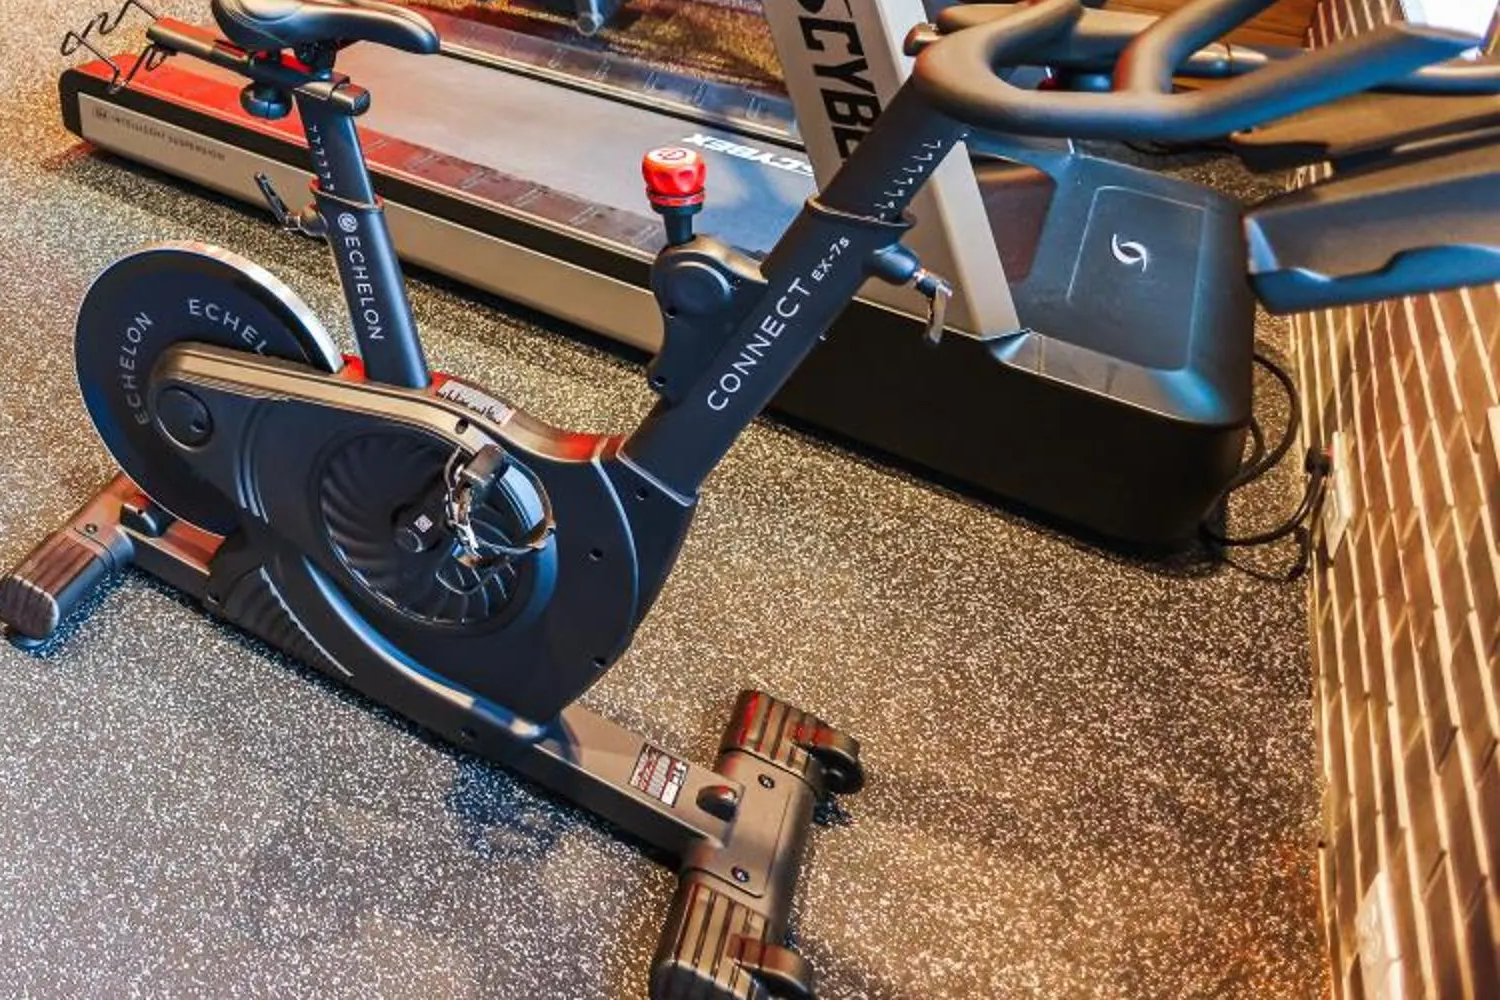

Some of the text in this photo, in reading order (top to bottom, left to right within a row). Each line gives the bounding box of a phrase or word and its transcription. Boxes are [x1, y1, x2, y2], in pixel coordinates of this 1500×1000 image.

[798, 16, 884, 160] CYBE
[344, 236, 385, 340] ECHELON
[707, 277, 812, 411] CONNECT
[119, 311, 154, 426] ECHELON
